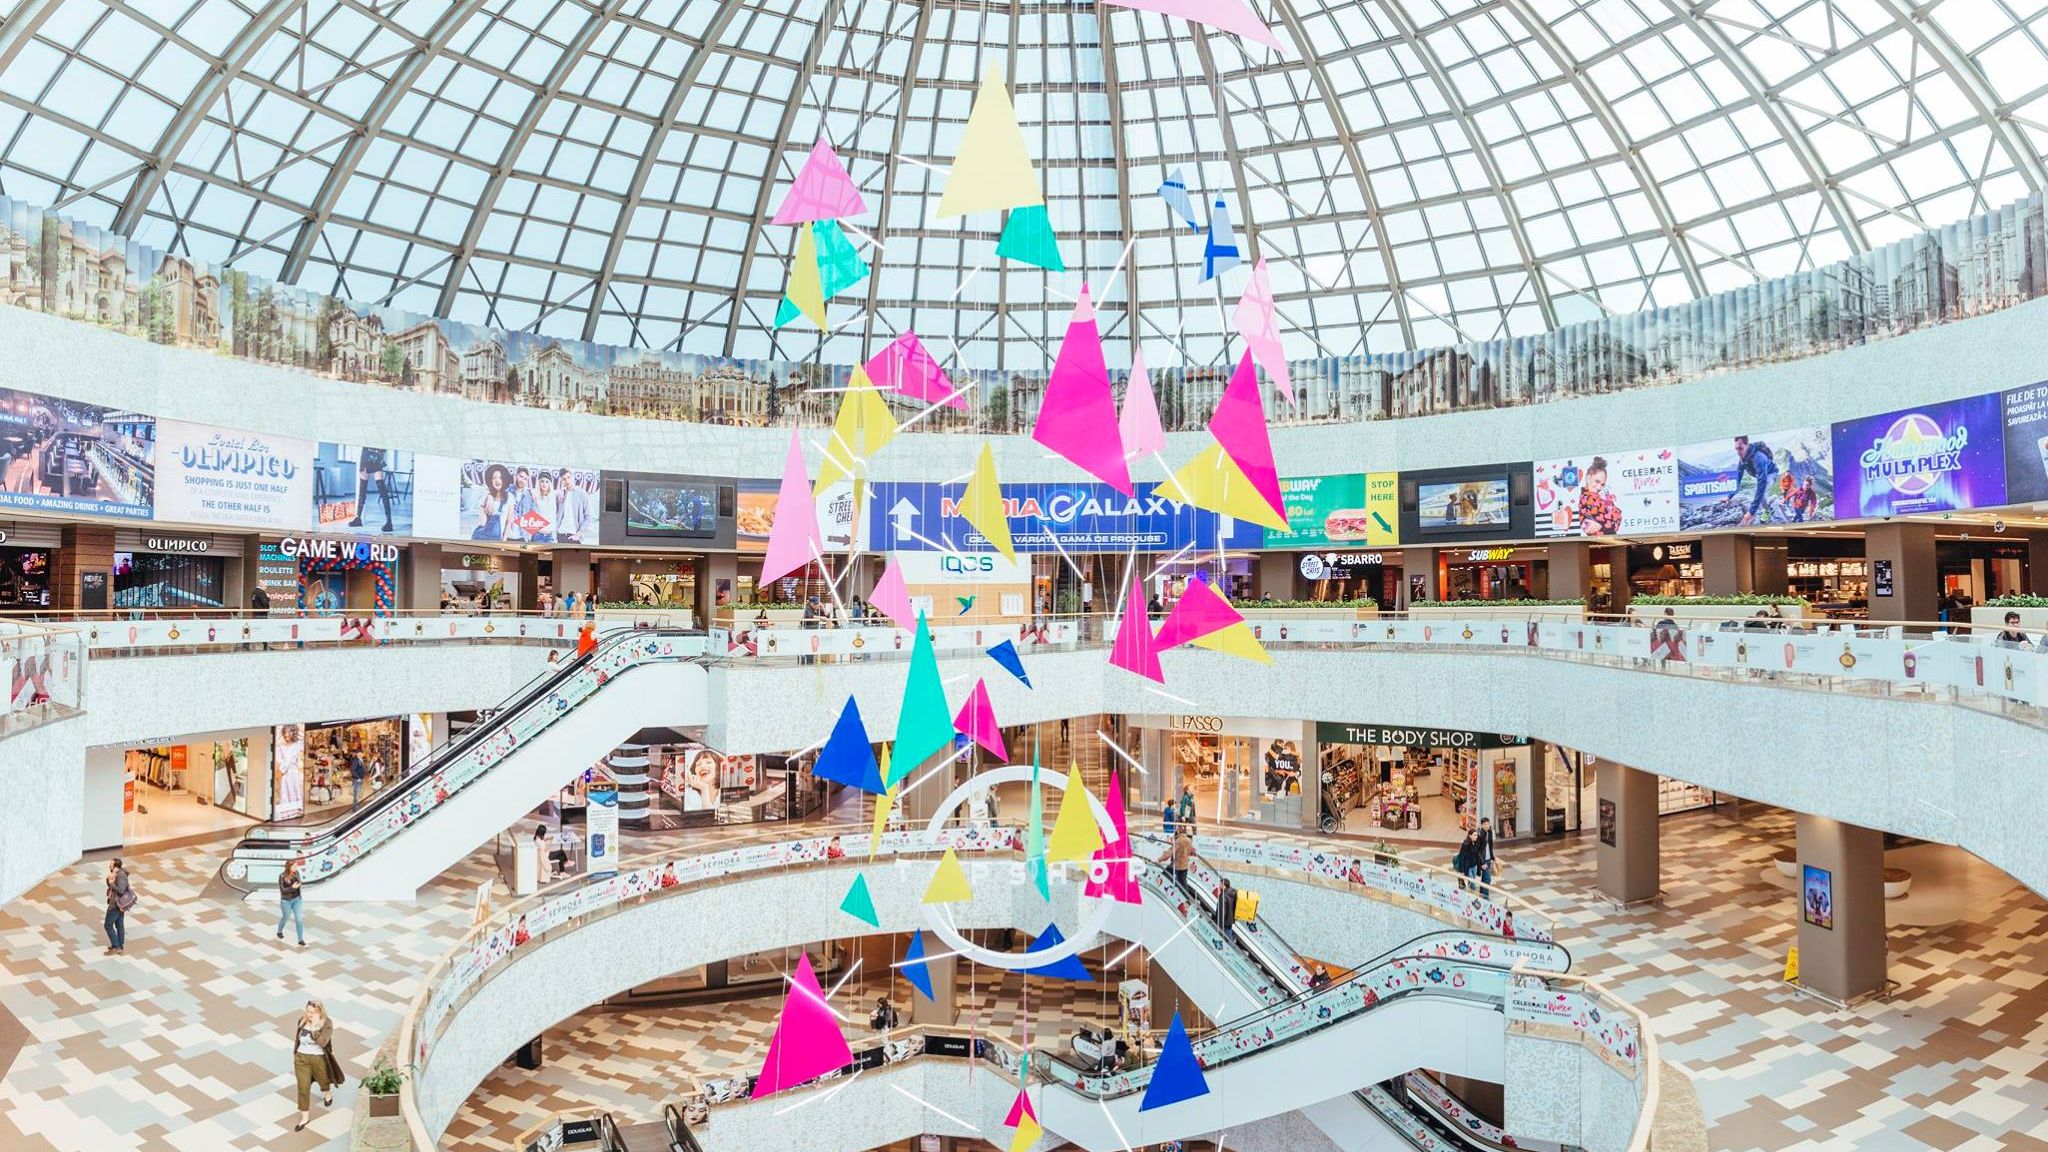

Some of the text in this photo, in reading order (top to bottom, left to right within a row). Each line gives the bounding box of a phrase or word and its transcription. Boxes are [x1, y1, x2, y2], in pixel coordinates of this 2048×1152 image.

[2006, 392, 2023, 405] FILE
[2024, 389, 2035, 400] DE
[2037, 401, 2045, 409] LA
[180, 445, 296, 480] OLIMPICO
[1867, 452, 1962, 480] MULTIPLEX
[1622, 465, 1673, 478] CELEBRATE
[184, 475, 289, 494] SHOPPING IS JUST ONE HALF
[1371, 481, 1394, 489] STOP
[1685, 480, 1737, 496] SPORTISIMO
[1371, 493, 1394, 501] HERE
[14, 496, 34, 506] FOOD
[40, 498, 74, 510] AMAZING
[75, 502, 99, 512] DRINKS
[105, 505, 124, 514] GREAT
[201, 500, 271, 514] THE OTHER HALF IS
[829, 501, 853, 514] STREE
[941, 491, 1184, 523] MDIA GALAXY
[836, 511, 853, 524] CHE
[1624, 516, 1675, 527] SEPHORA
[148, 538, 208, 552] OLIMPICO
[260, 544, 277, 552] SLOT
[280, 537, 399, 562] GAME WORLD
[1340, 553, 1383, 565] SBARRO
[1468, 548, 1514, 560] SUBWAY
[1169, 714, 1223, 731] IL PASSO
[1346, 728, 1376, 743] THE
[1382, 730, 1427, 745] BODY
[1224, 845, 1263, 856] SEPHORA
[1390, 876, 1426, 893] SEPHORA
[1504, 949, 1552, 962] SEPHORA
[568, 1127, 592, 1135] DOUGLAS
